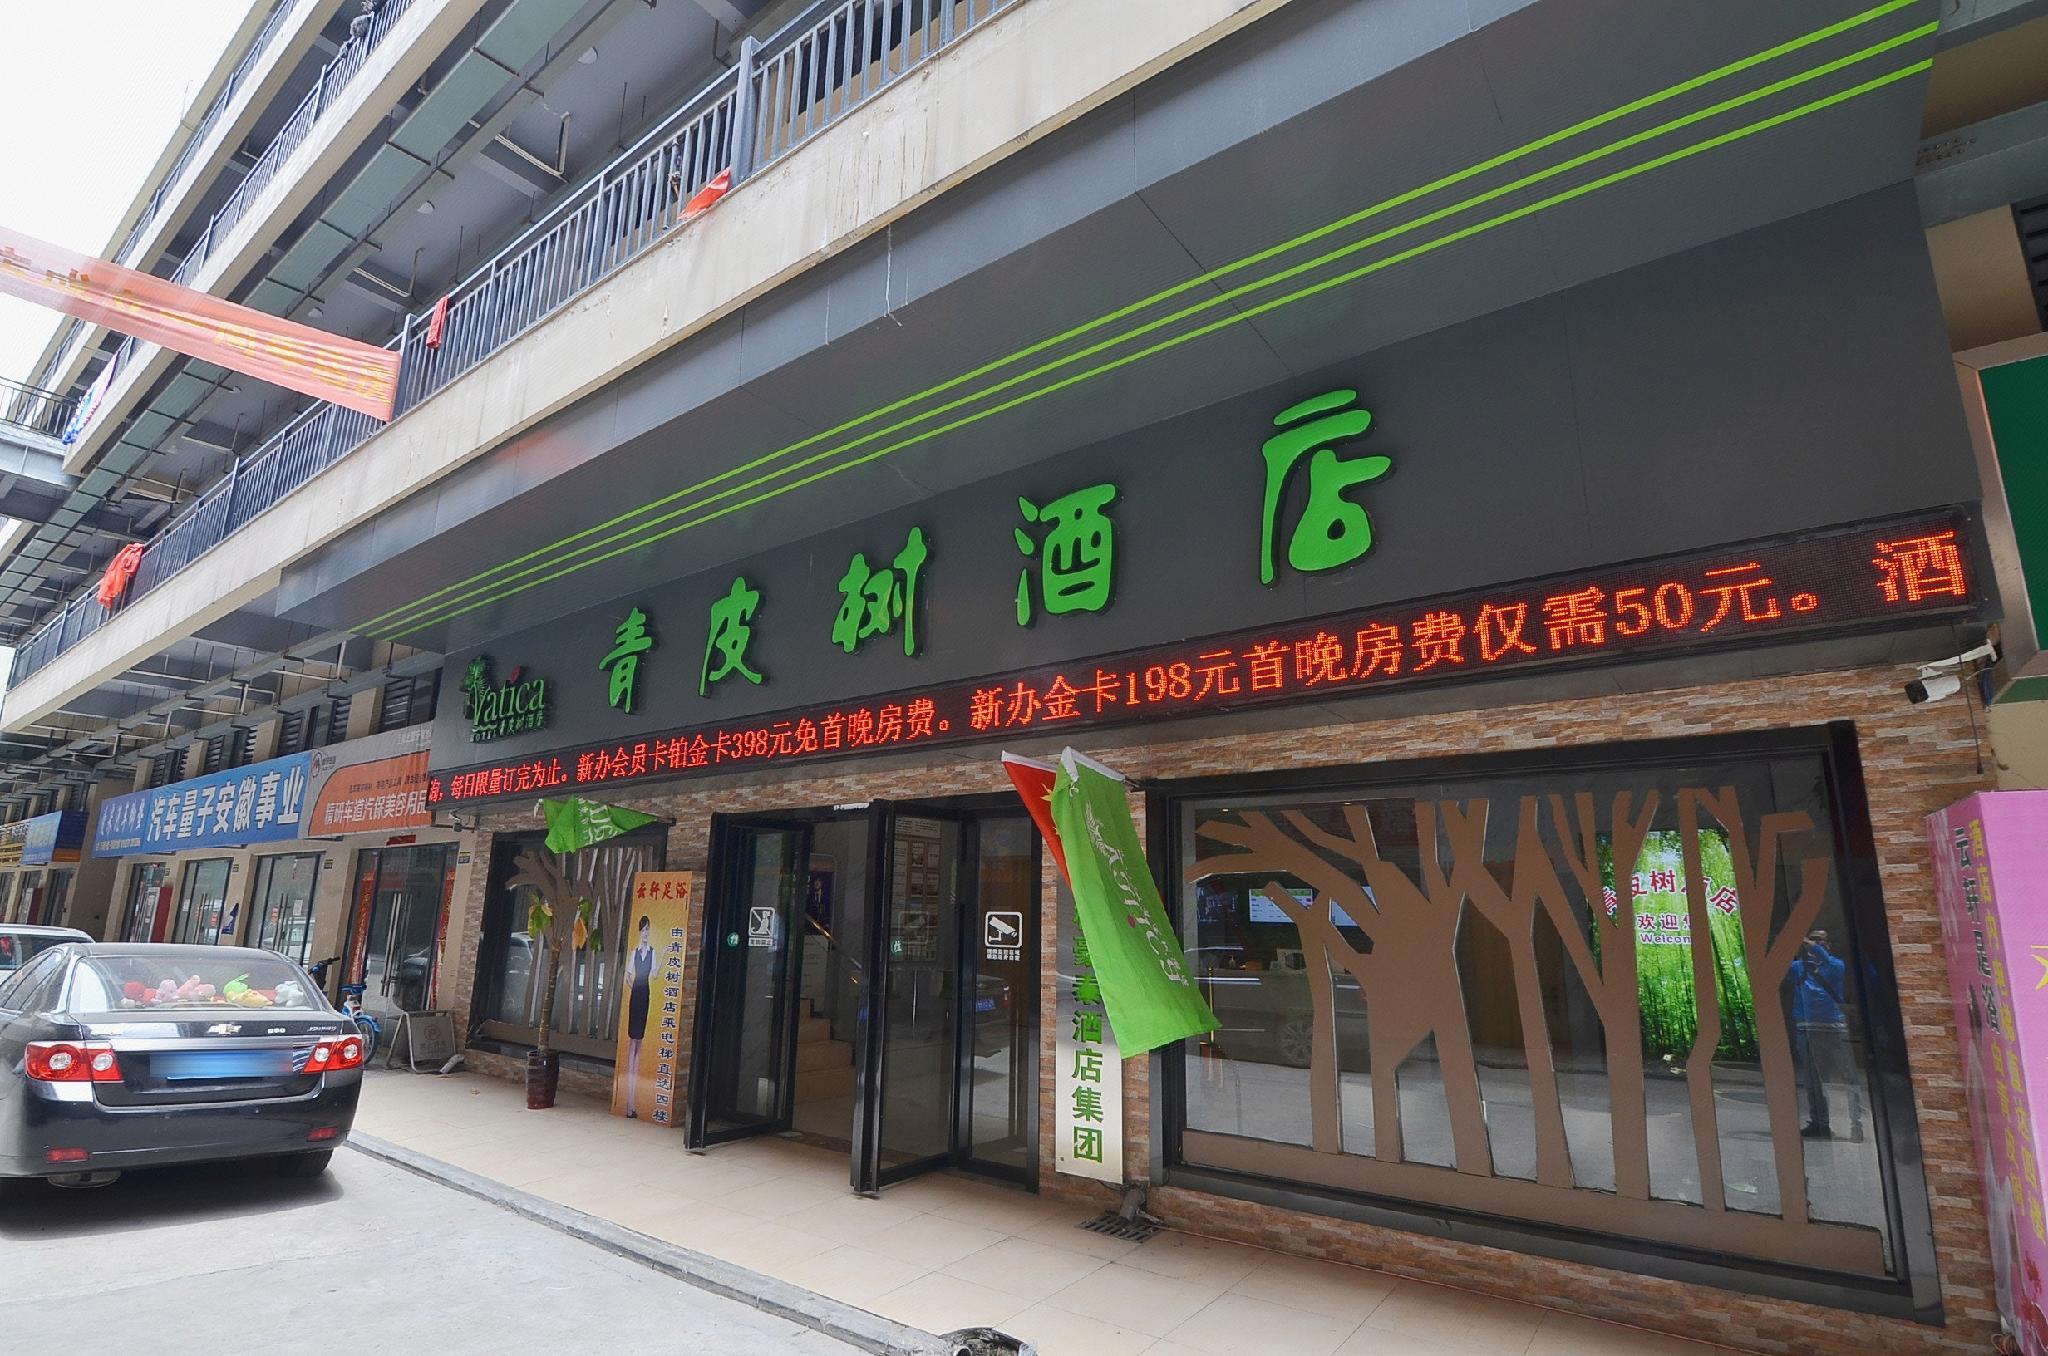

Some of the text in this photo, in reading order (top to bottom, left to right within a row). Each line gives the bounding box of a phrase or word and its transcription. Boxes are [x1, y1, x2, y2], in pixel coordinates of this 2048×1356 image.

[599, 388, 1393, 714] 青皮树酒店
[465, 664, 545, 726] Vatica
[147, 766, 306, 842] 汽车量子安徽事业
